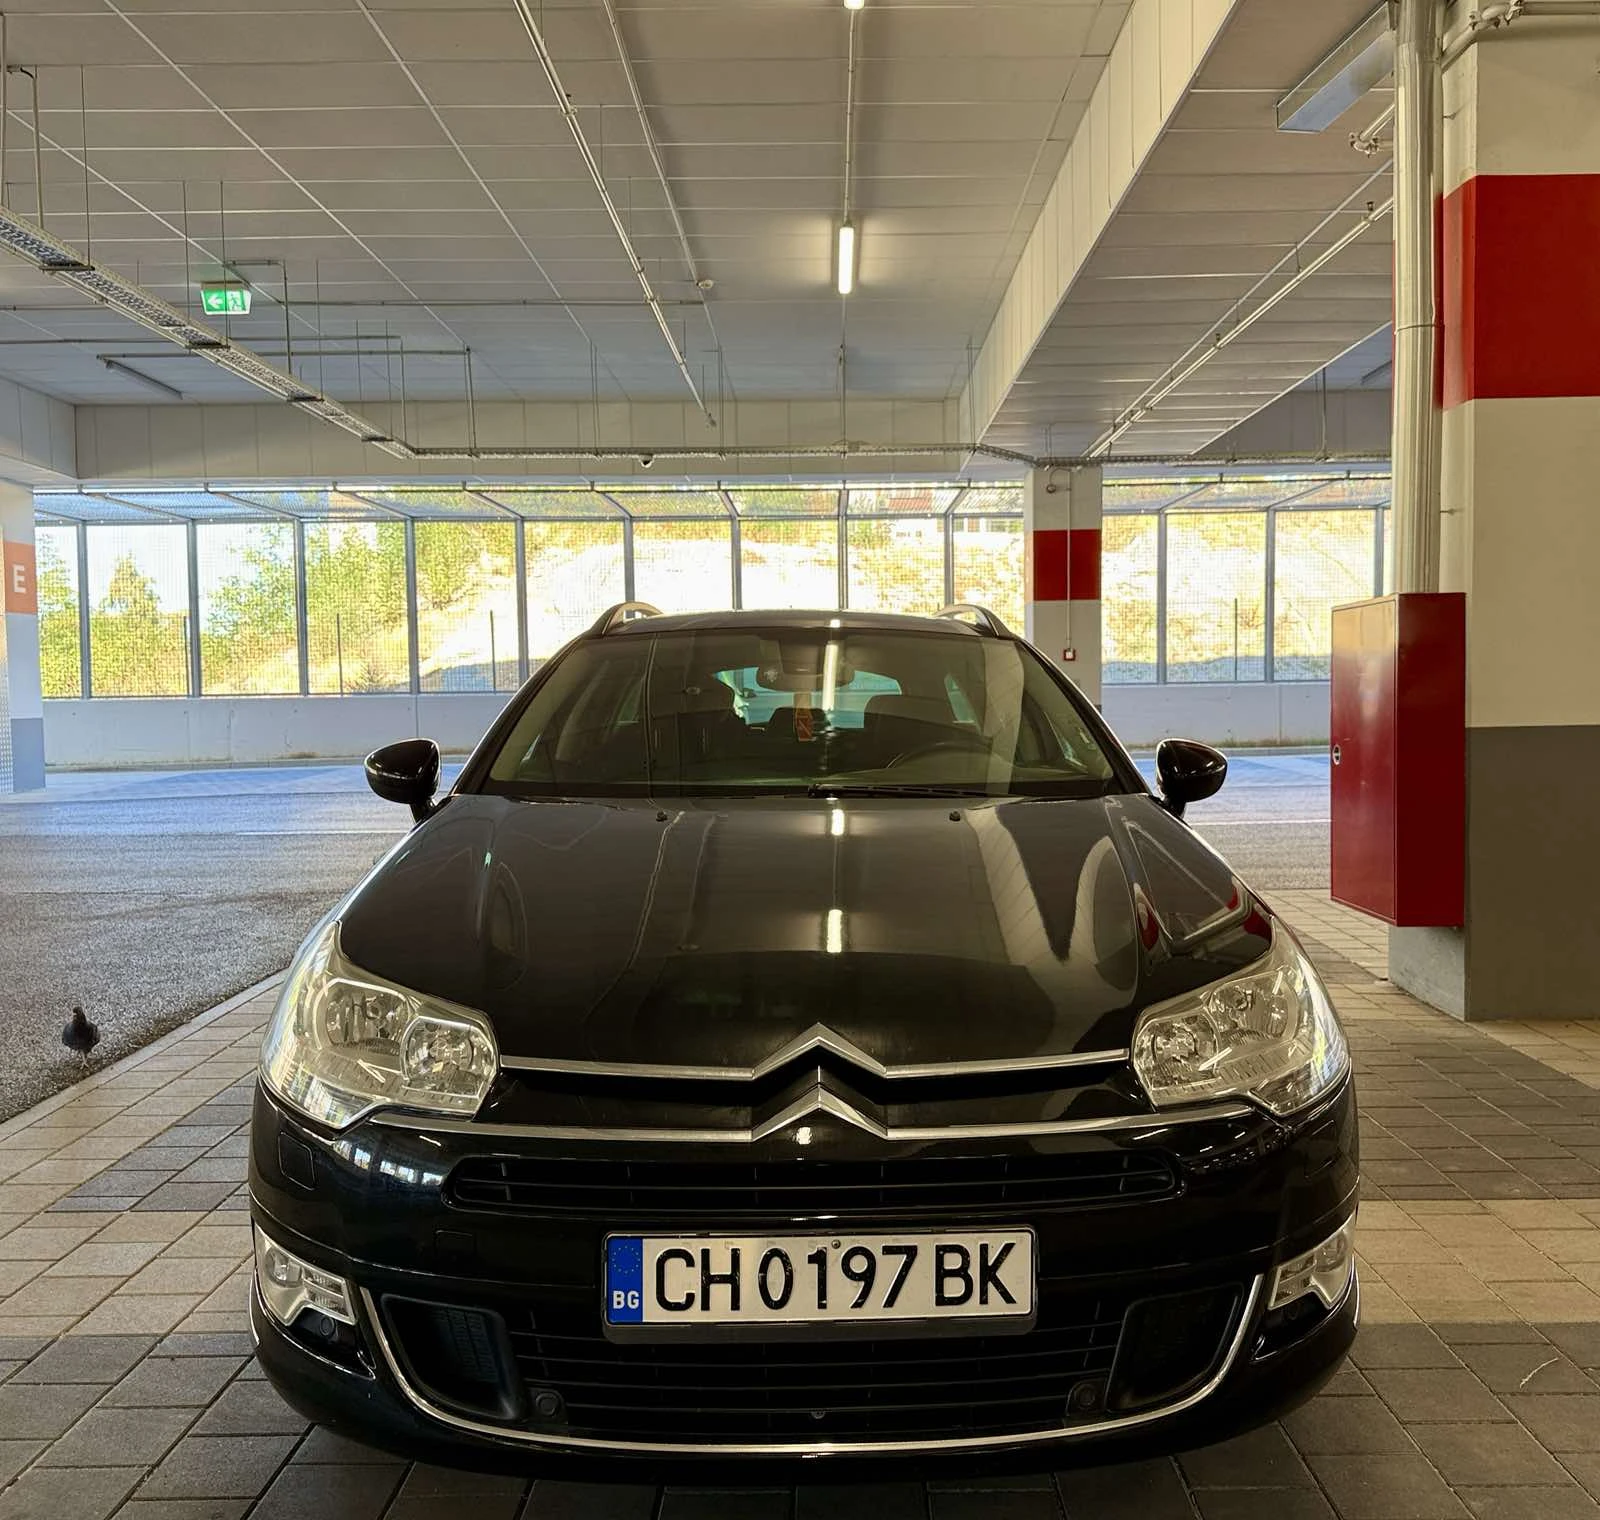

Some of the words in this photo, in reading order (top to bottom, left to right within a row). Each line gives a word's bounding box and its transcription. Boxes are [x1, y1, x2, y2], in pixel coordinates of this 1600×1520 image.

[13, 564, 26, 593] E
[655, 1247, 741, 1312] CH
[757, 1243, 919, 1311] 0197
[934, 1242, 1018, 1307] BK
[612, 1291, 640, 1309] BG
